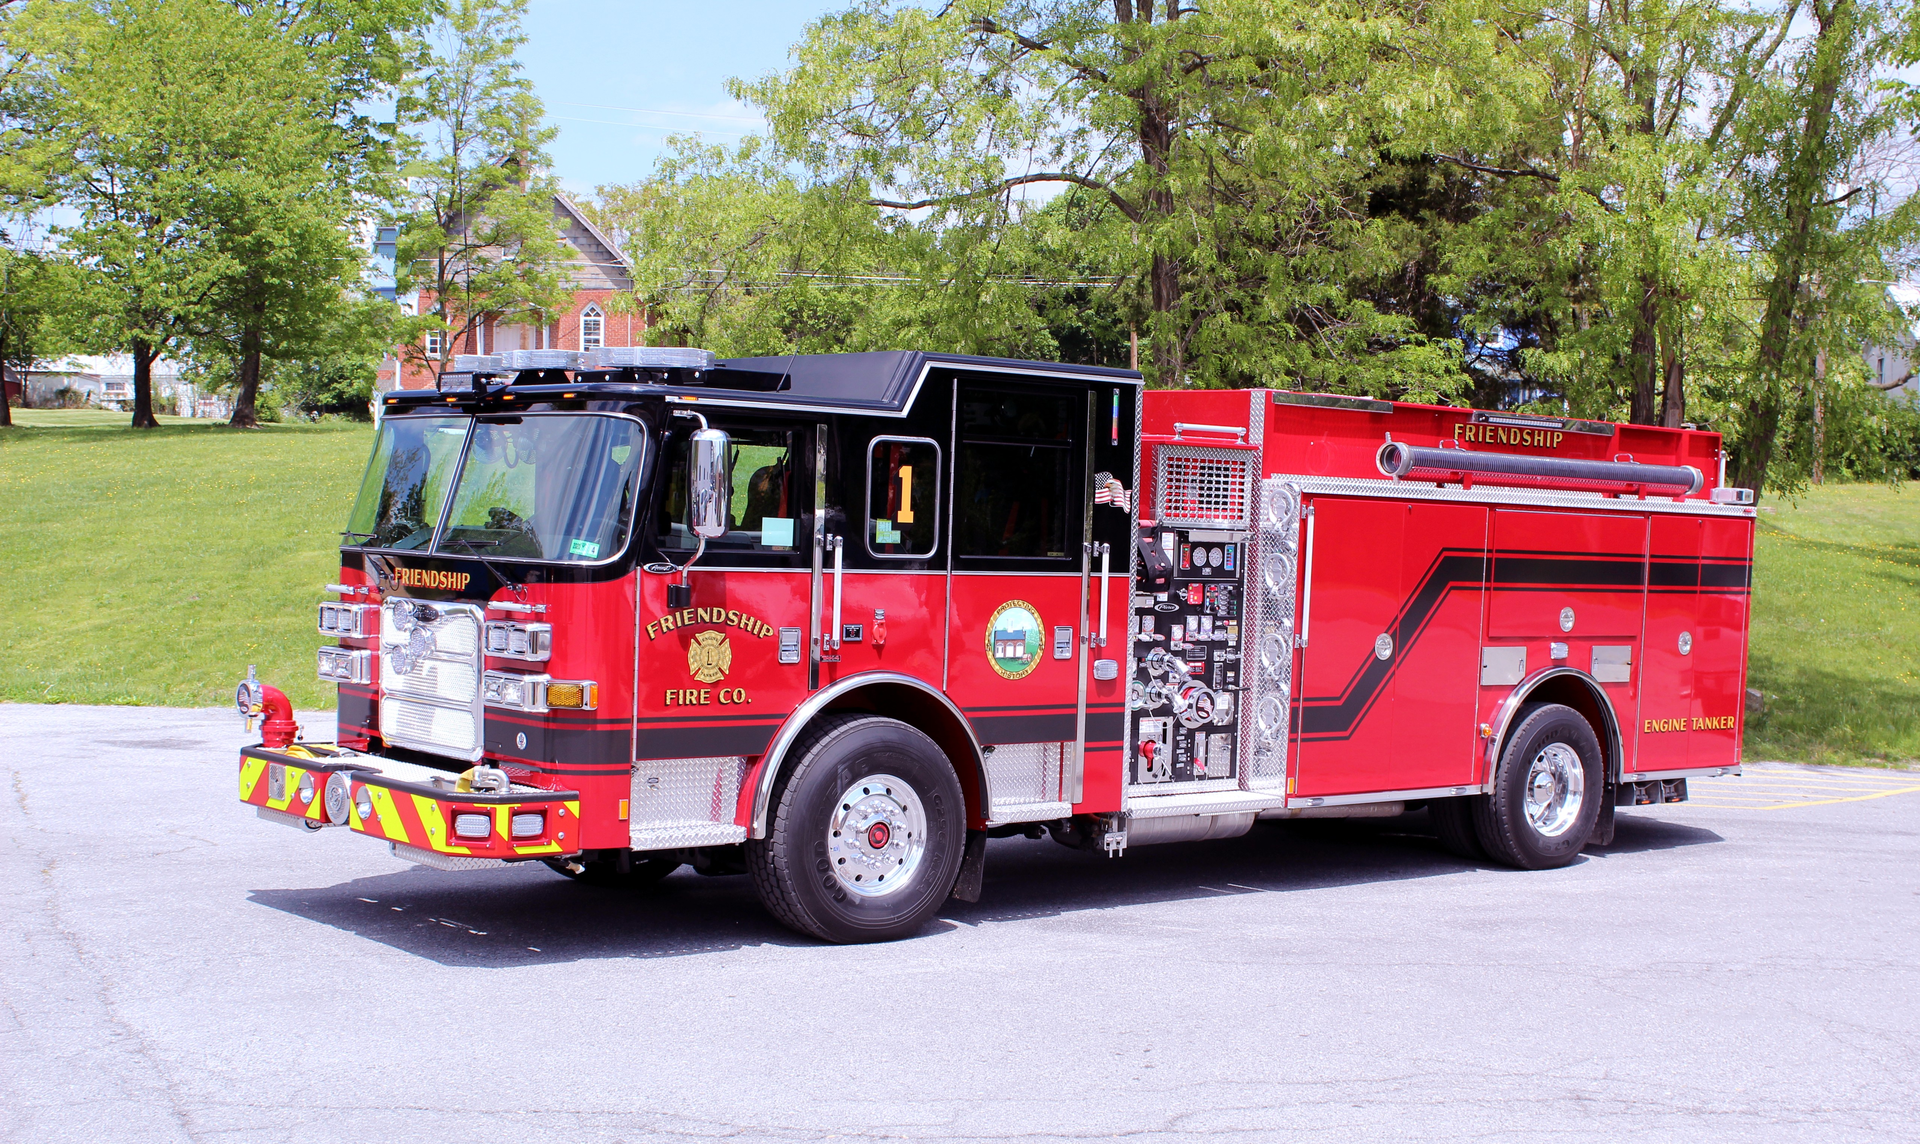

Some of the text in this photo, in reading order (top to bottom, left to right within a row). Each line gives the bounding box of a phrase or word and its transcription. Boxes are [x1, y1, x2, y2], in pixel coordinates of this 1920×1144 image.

[1454, 423, 1563, 448] FRIENDSHIP
[897, 465, 914, 523] 1
[394, 567, 471, 590] FRIENDSHIP
[996, 601, 1035, 615] PROTECTING
[645, 607, 774, 640] FRIENDSHIP
[1000, 669, 1029, 679] HISTORY
[665, 687, 752, 706] FIRE CO.
[1644, 716, 1735, 733] ENGINE TANKER
